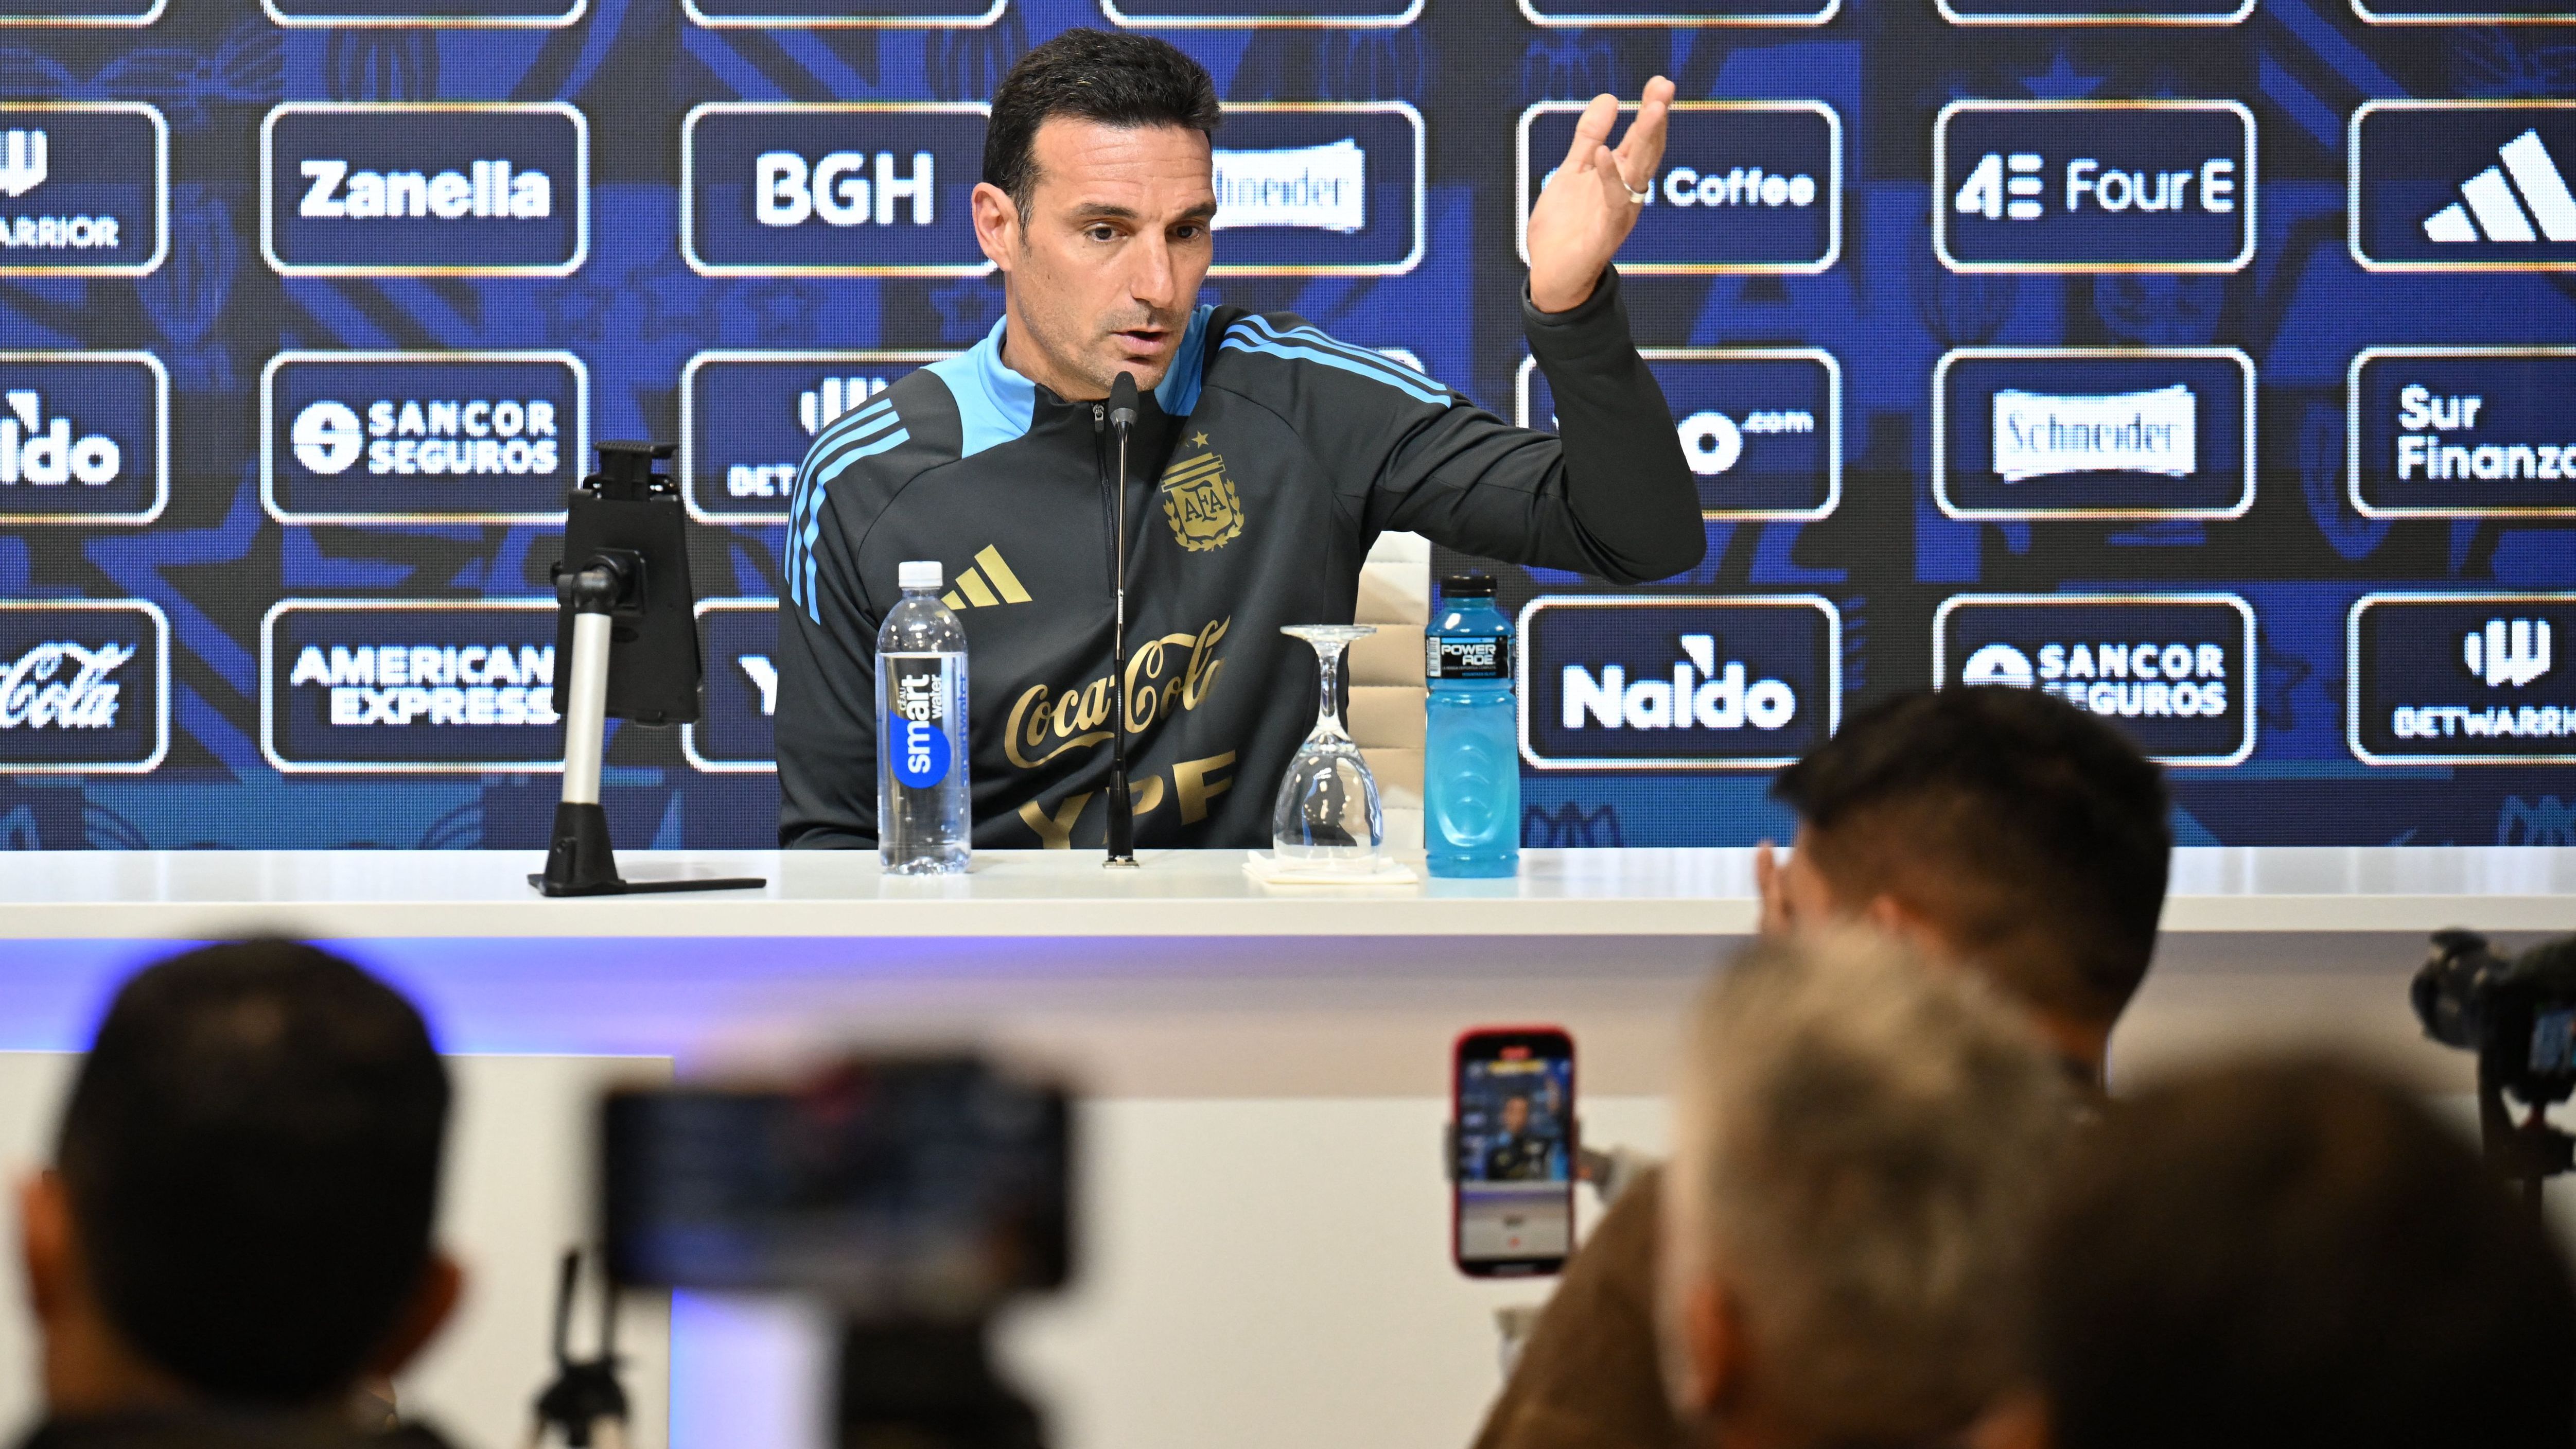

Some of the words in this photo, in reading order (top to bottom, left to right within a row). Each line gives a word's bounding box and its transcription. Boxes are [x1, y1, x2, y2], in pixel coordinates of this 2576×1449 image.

[300, 160, 551, 219] Zanella
[756, 152, 933, 226] BGH
[1663, 167, 1815, 206] Coffee
[2066, 158, 2193, 212] Four
[2200, 159, 2234, 213] E
[369, 400, 557, 437] SANCOR
[2399, 383, 2483, 431] Sur
[2008, 411, 2181, 453] Schneider
[369, 438, 559, 475] SEGUROS
[727, 464, 799, 496] BET
[290, 645, 555, 686] AMERICAN
[1441, 644, 1496, 655] POWER
[1462, 654, 1495, 666] ADE
[2038, 643, 2226, 678] SANCOR
[331, 687, 560, 725] EXPRESS
[930, 674, 942, 719] water
[1563, 660, 1795, 729] Naldo
[901, 674, 931, 774] smart
[1018, 749, 1235, 850] YPF
